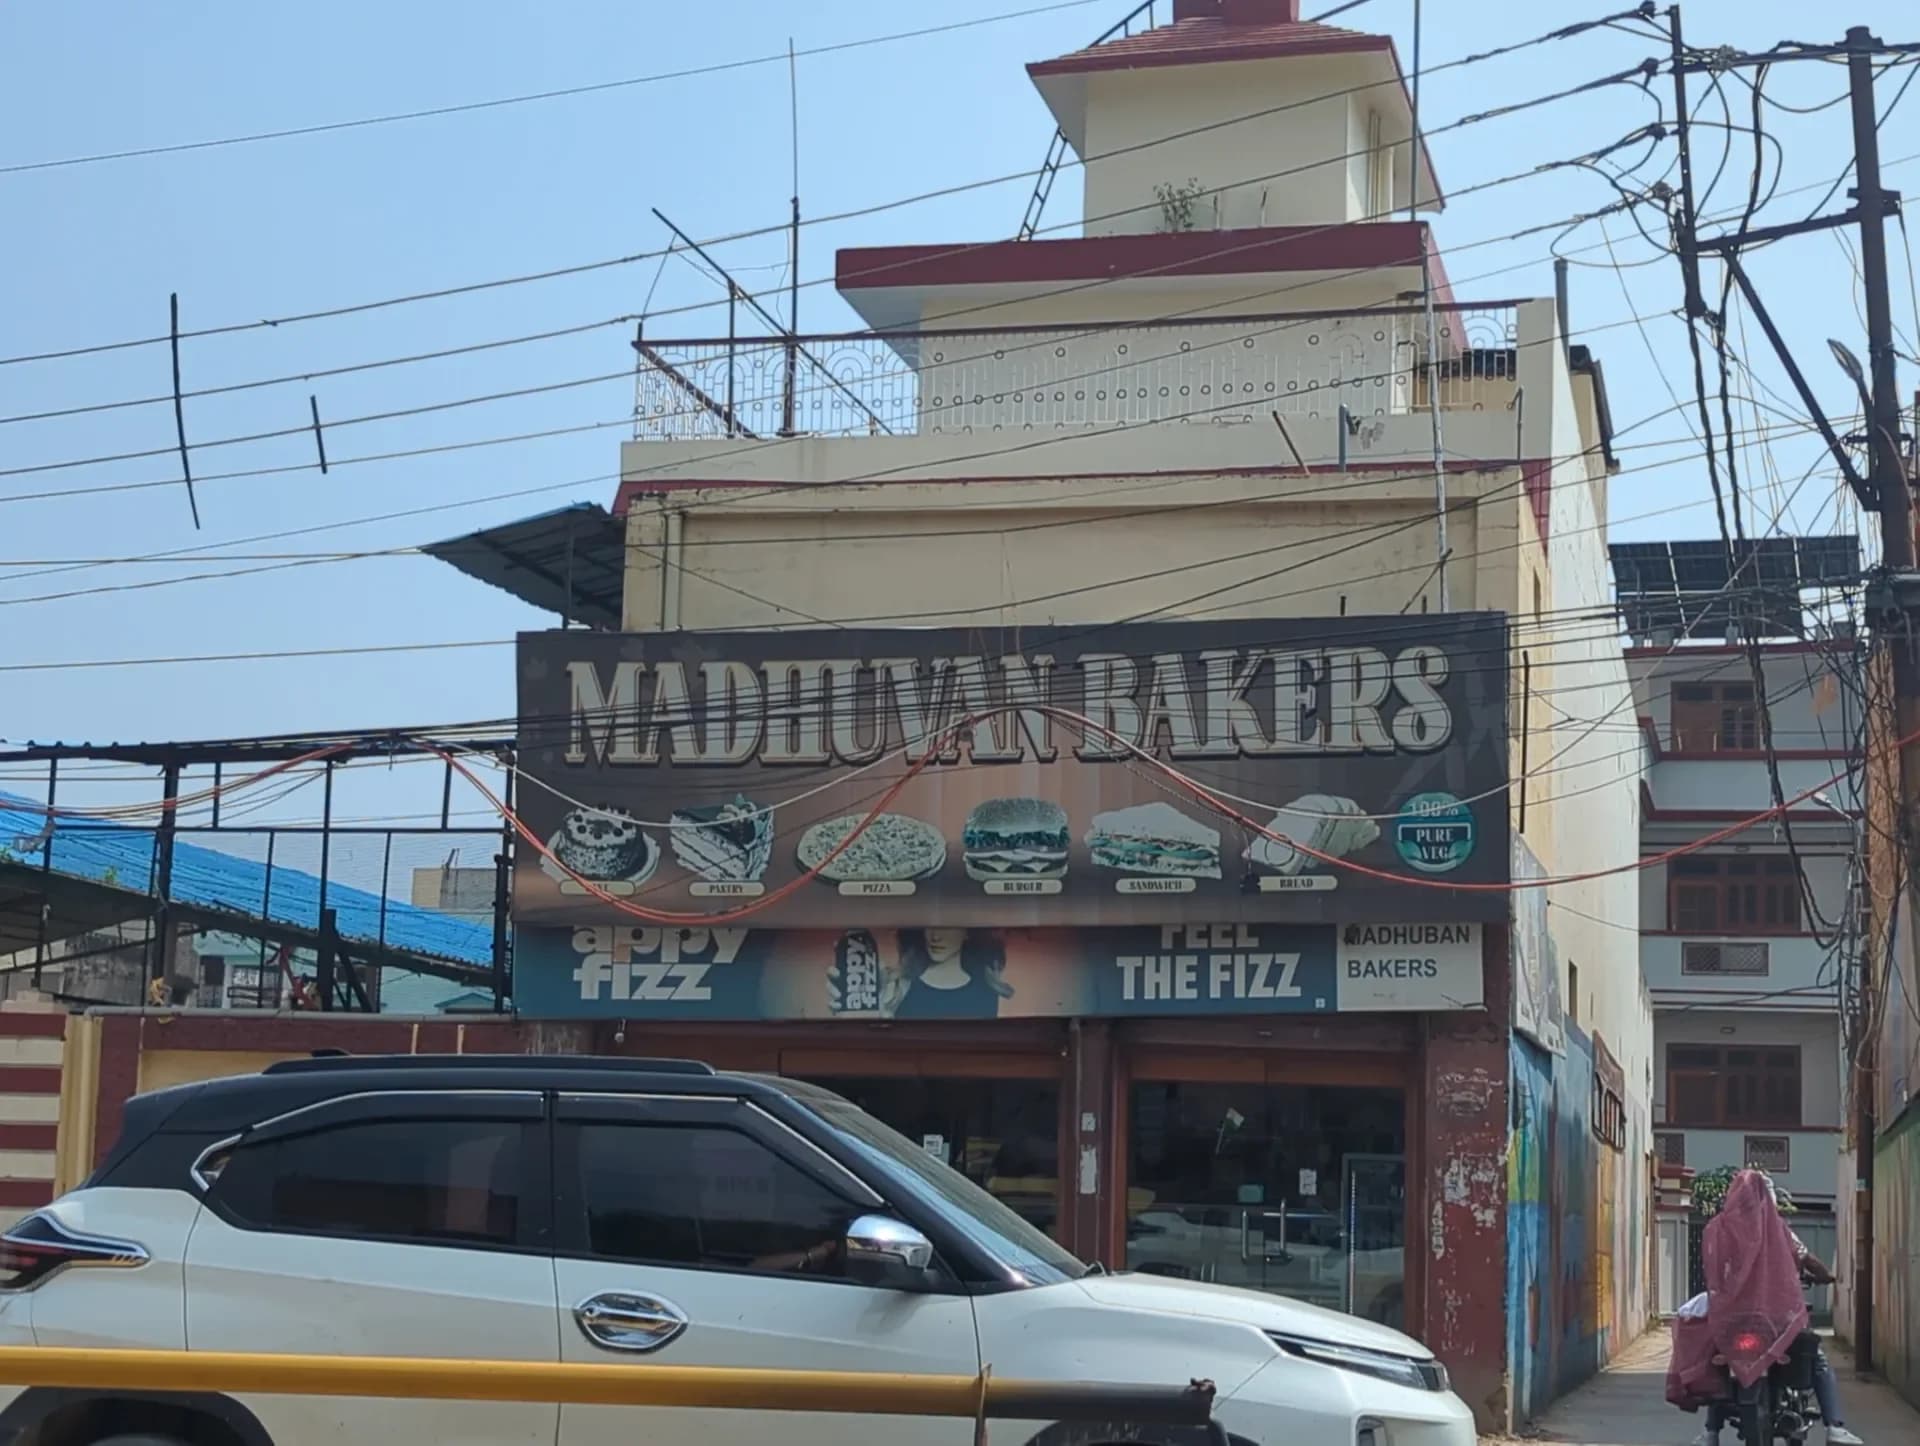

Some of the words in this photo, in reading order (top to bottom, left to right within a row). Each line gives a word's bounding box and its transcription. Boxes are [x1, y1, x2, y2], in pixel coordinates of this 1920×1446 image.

[564, 653, 1057, 766] MADHUVAN
[1076, 645, 1453, 760] BAKERS
[1416, 829, 1454, 842] PURE
[1422, 846, 1451, 861] VEG
[708, 885, 744, 894] PASTRY
[863, 884, 892, 893] PIZZA
[1003, 881, 1043, 891] BURGER
[1129, 880, 1183, 890] SANDWICH
[1280, 878, 1314, 889] BREAD
[1348, 959, 1438, 979] BAKERS
[573, 953, 712, 1000] fizz
[1116, 956, 1198, 1000] THE
[1209, 953, 1301, 999] FIZZ
